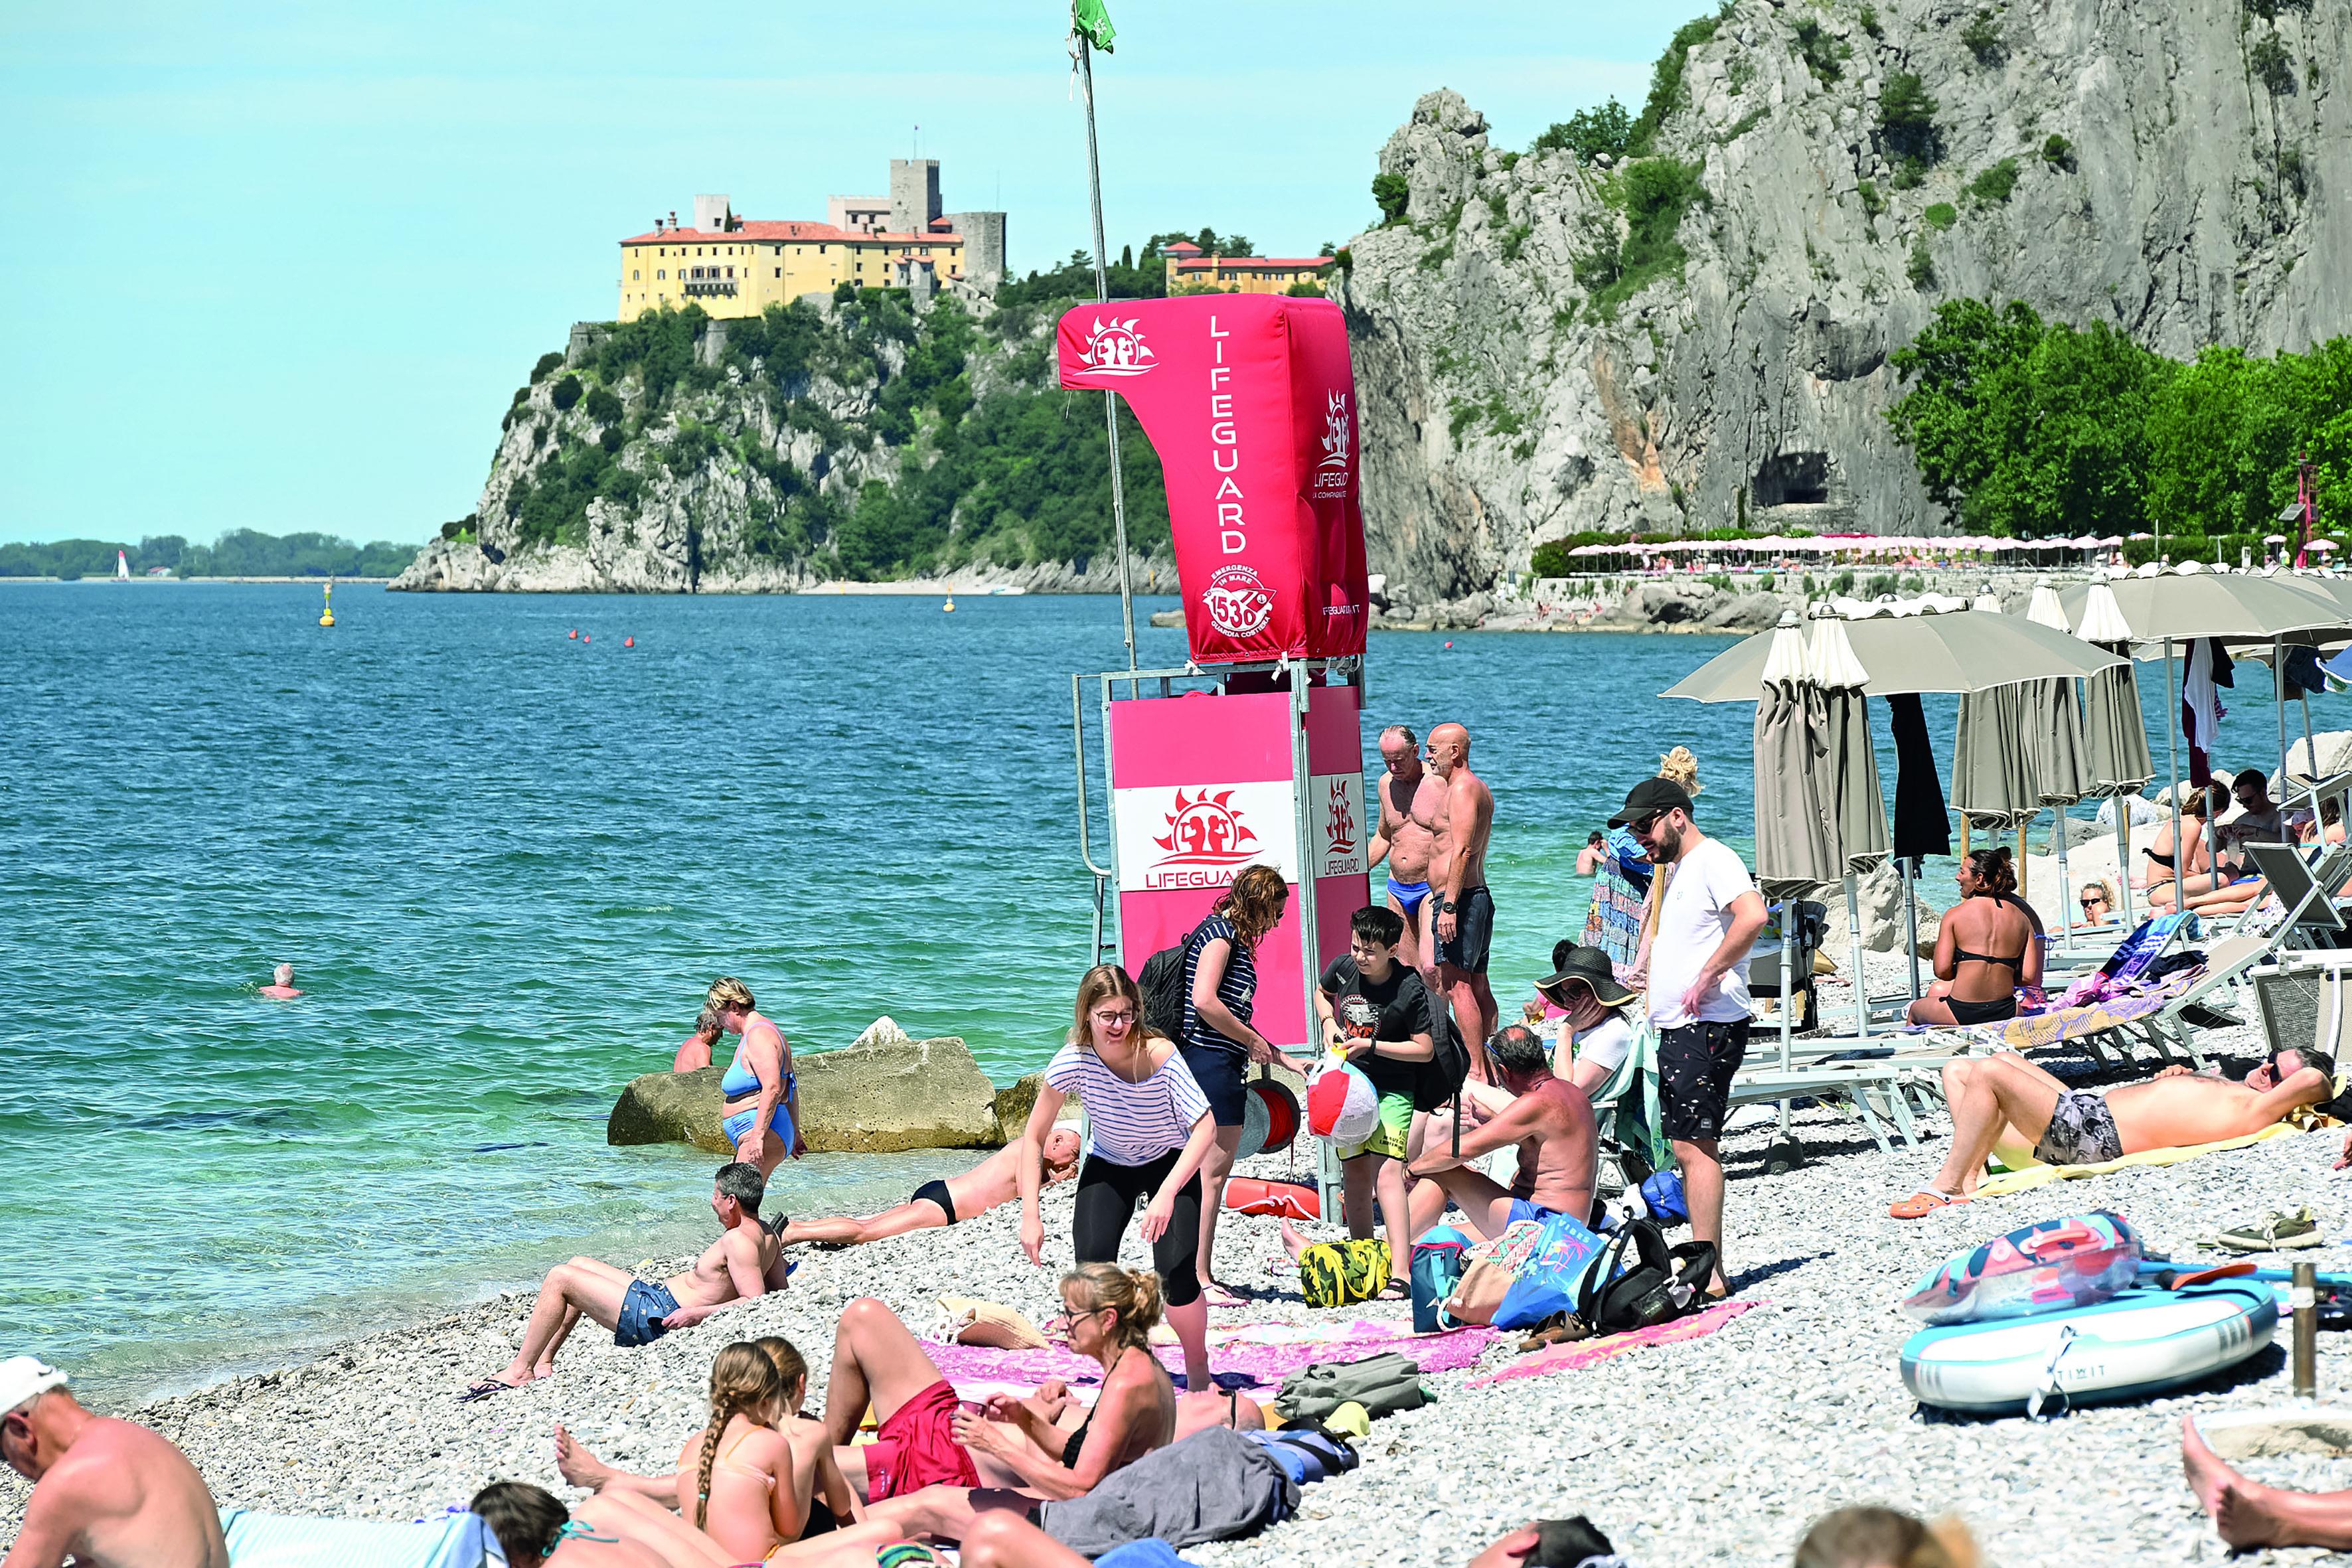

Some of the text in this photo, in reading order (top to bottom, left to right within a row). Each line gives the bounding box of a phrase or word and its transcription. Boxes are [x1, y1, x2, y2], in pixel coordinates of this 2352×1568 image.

[1210, 315, 1247, 554] LIFEGUARD
[1211, 564, 1258, 580] EMERGENZA
[1218, 575, 1253, 586] IN MARE
[1211, 595, 1256, 628] 1530
[1211, 616, 1271, 638] GUARDIA COSTIERA
[1324, 858, 1360, 875] LIFEGUARD
[1146, 870, 1242, 888] LIFEGUA
[1558, 1219, 1591, 1243] VIBES
[2057, 1365, 2104, 1381] TIWIT
